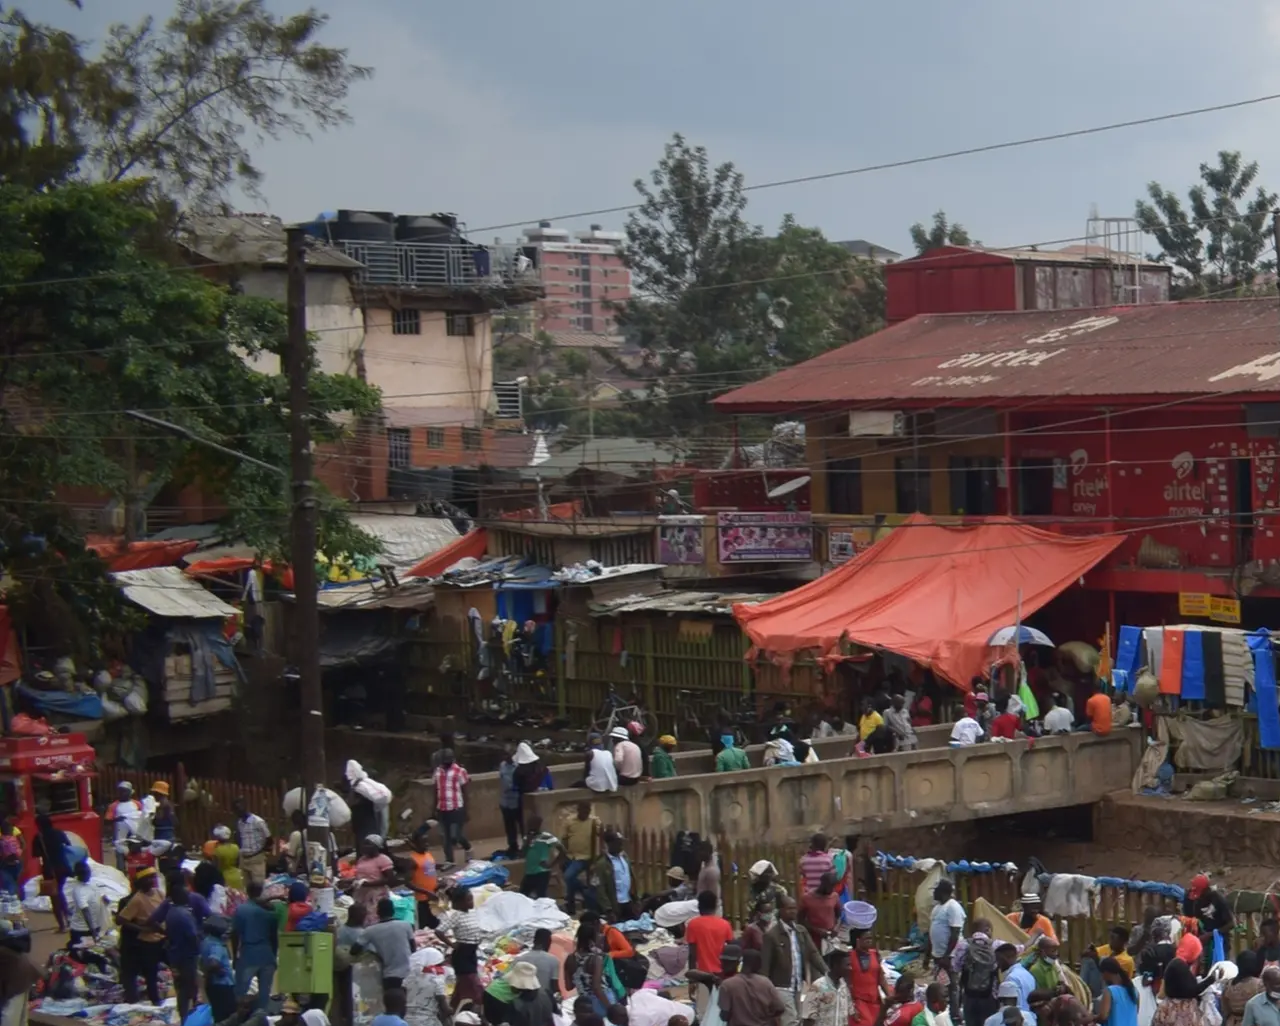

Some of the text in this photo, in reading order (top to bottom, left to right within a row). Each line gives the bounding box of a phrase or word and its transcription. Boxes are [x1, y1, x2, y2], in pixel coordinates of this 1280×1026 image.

[938, 348, 1067, 369] airtel
[1073, 479, 1100, 497] rtel
[1164, 481, 1206, 500] airtel
[1073, 502, 1097, 514] oney
[1169, 507, 1203, 517] money
